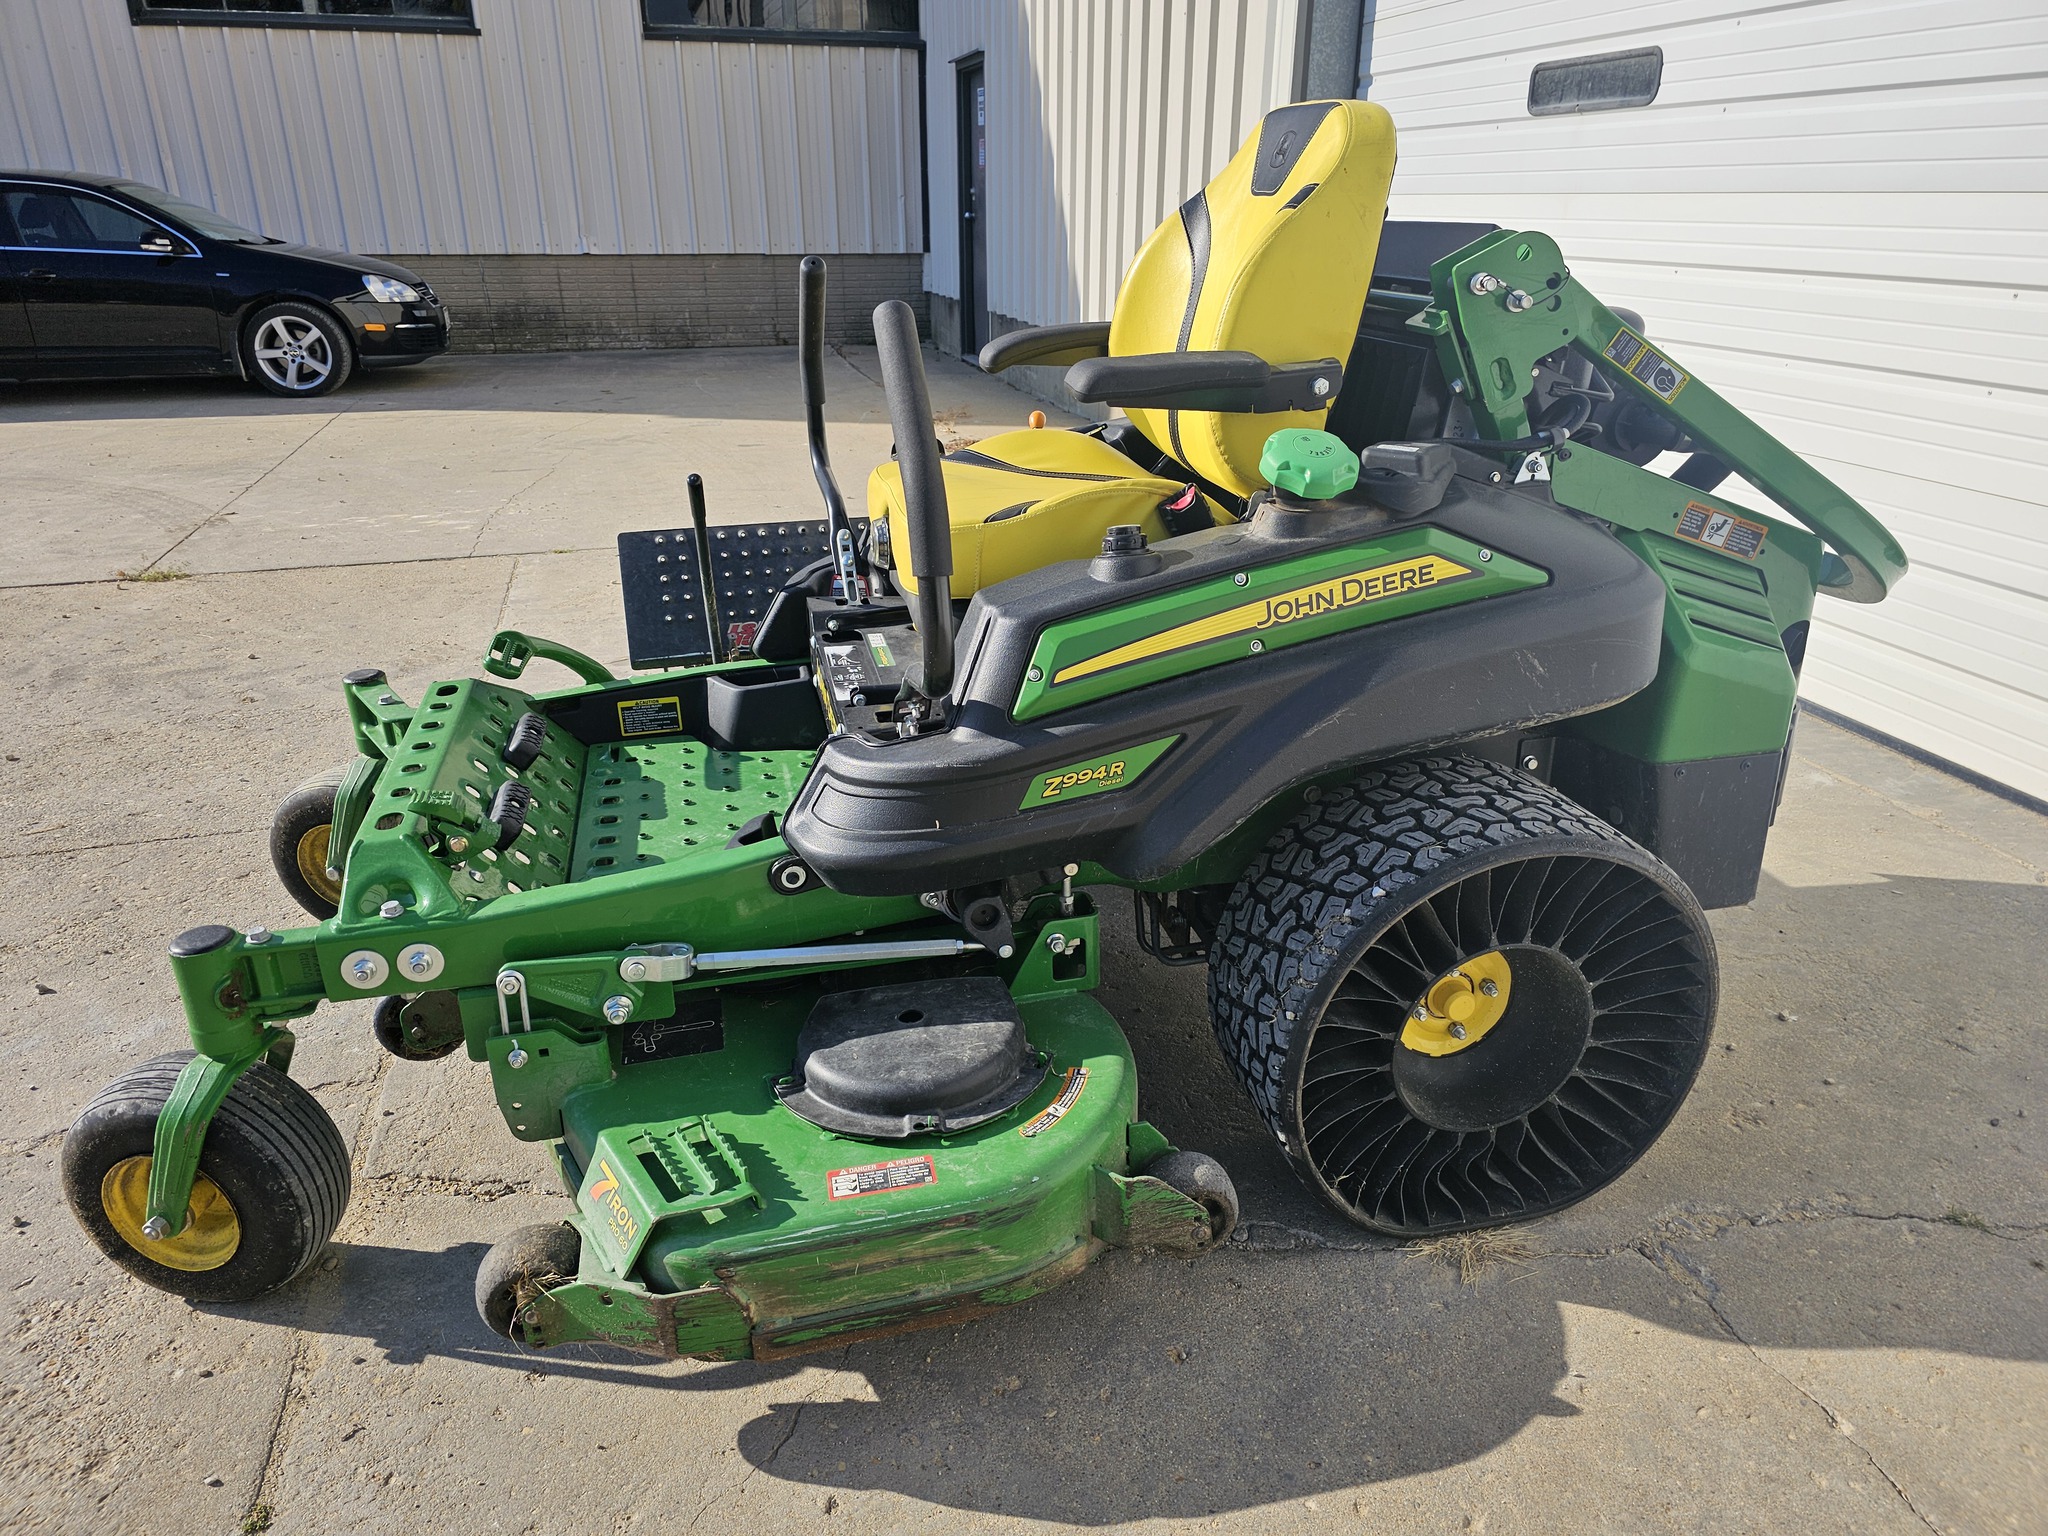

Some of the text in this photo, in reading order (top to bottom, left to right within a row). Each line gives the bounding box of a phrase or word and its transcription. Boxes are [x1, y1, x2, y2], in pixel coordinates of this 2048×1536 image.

[1257, 563, 1435, 627] JOHN DEERE
[1041, 761, 1125, 798] Z994R
[1098, 776, 1124, 788] Diesel
[848, 1164, 877, 1174] DANGER
[895, 1156, 925, 1166] PELIGRO
[607, 1217, 628, 1250] PRO 60
